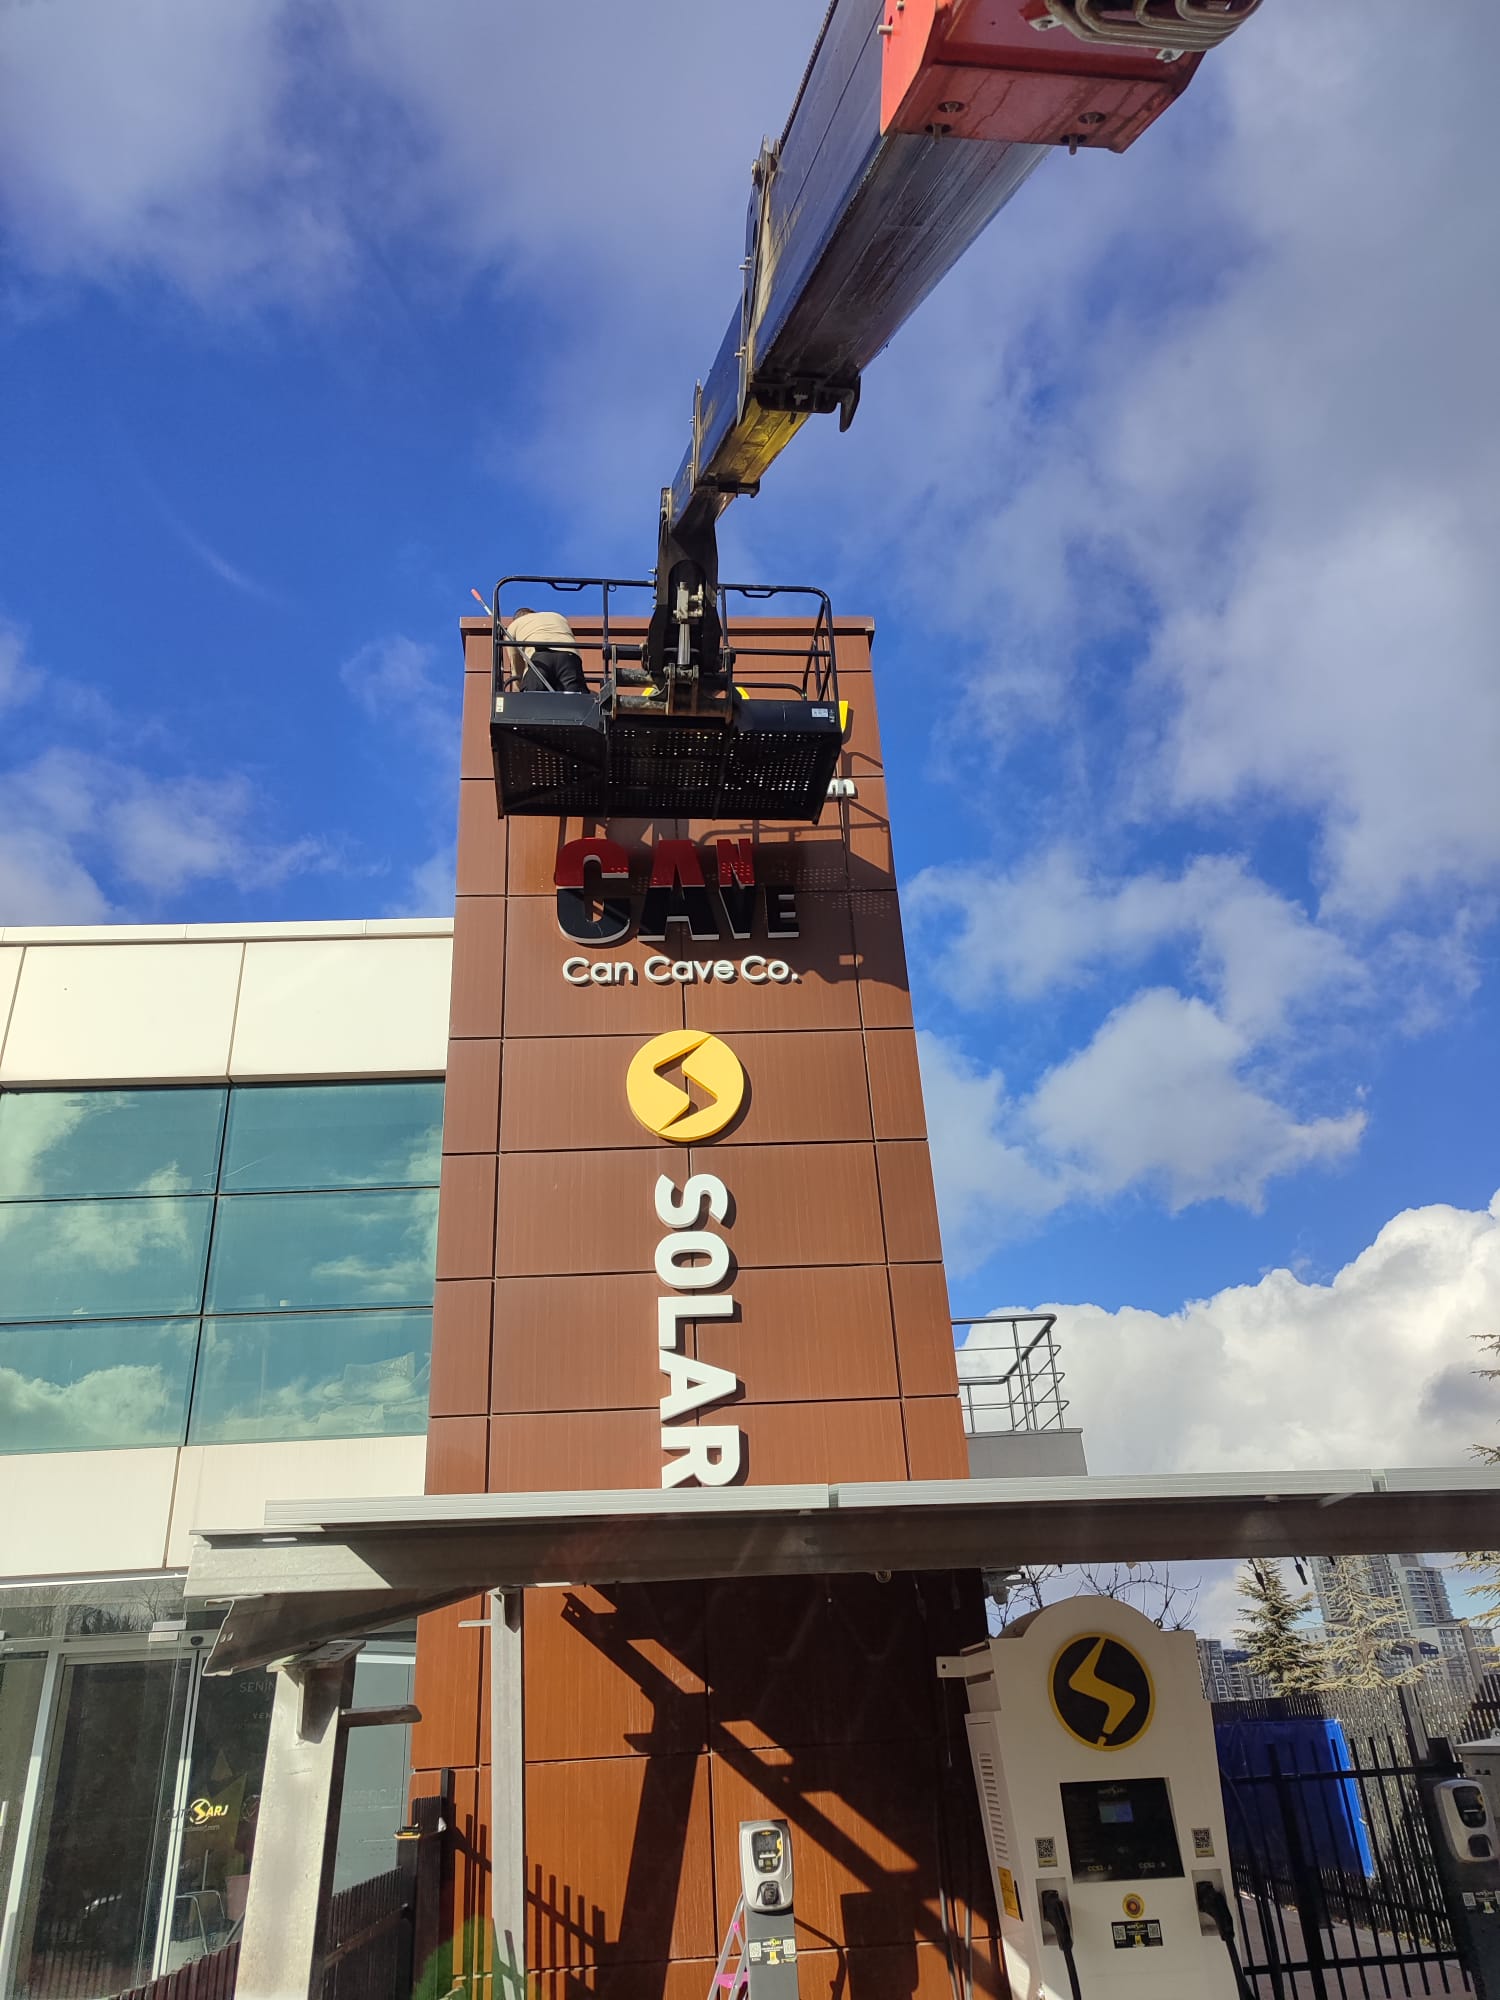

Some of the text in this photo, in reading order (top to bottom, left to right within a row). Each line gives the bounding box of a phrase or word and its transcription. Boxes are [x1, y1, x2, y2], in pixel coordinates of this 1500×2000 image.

[562, 955, 800, 985] Can Cave Co.
[655, 1174, 741, 1488] SOLAR
